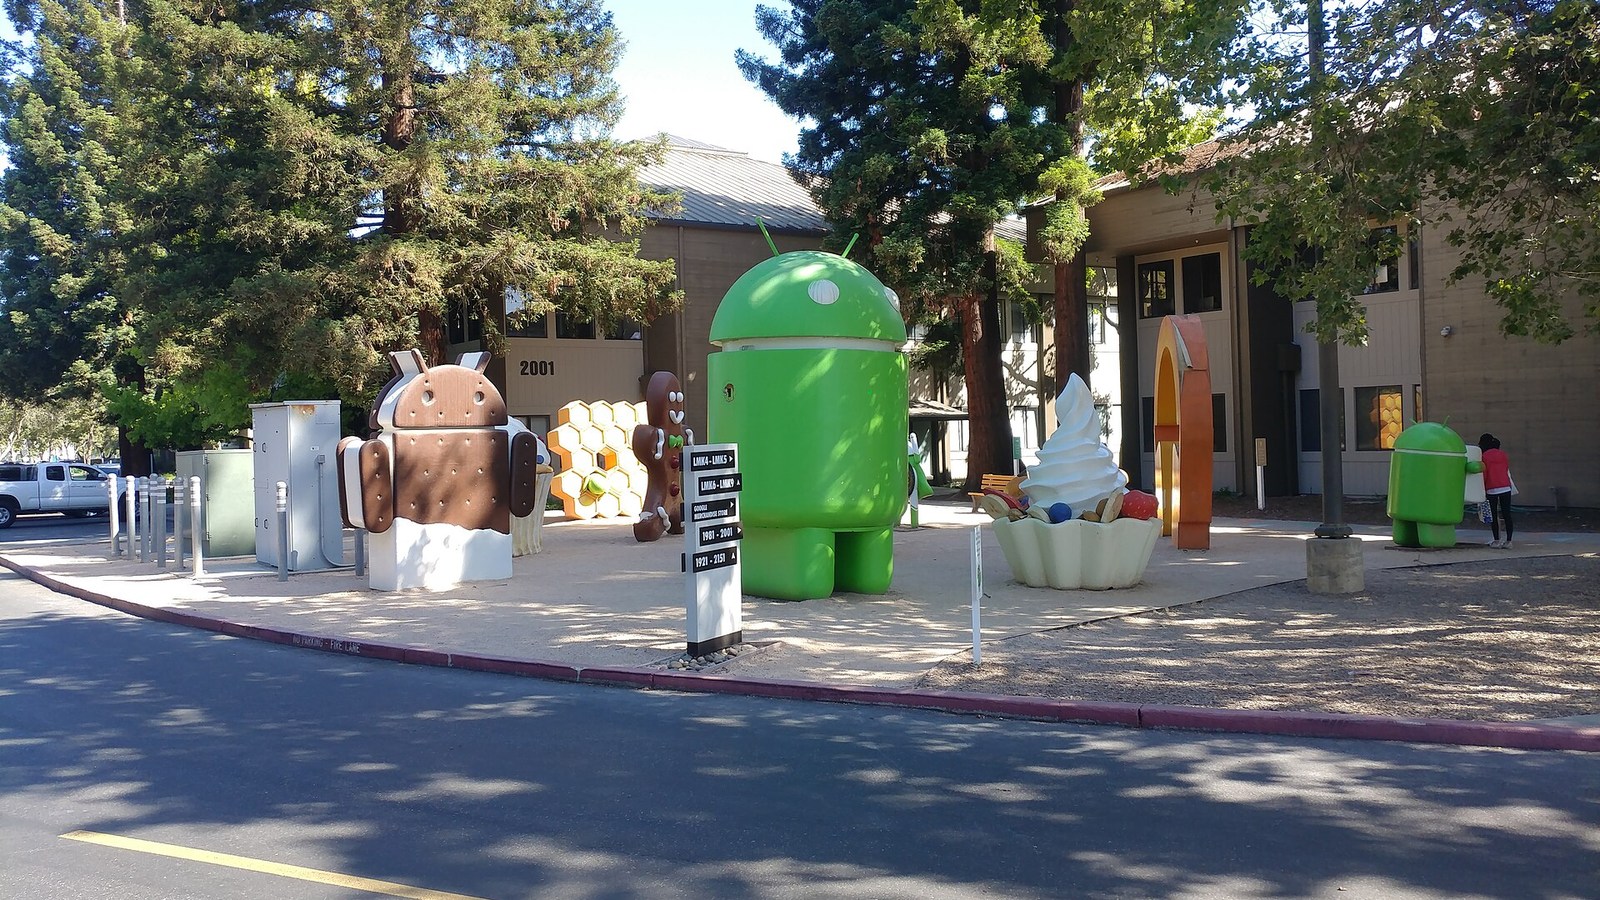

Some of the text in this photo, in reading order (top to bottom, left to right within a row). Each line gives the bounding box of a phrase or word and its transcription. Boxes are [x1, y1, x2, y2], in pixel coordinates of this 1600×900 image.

[520, 361, 554, 375] 2001
[702, 530, 715, 541] 1981
[720, 527, 733, 538] 2001
[695, 556, 708, 568] 1921
[713, 553, 726, 564] 2151
[330, 639, 343, 651] FIRE
[344, 642, 360, 653] LANE
